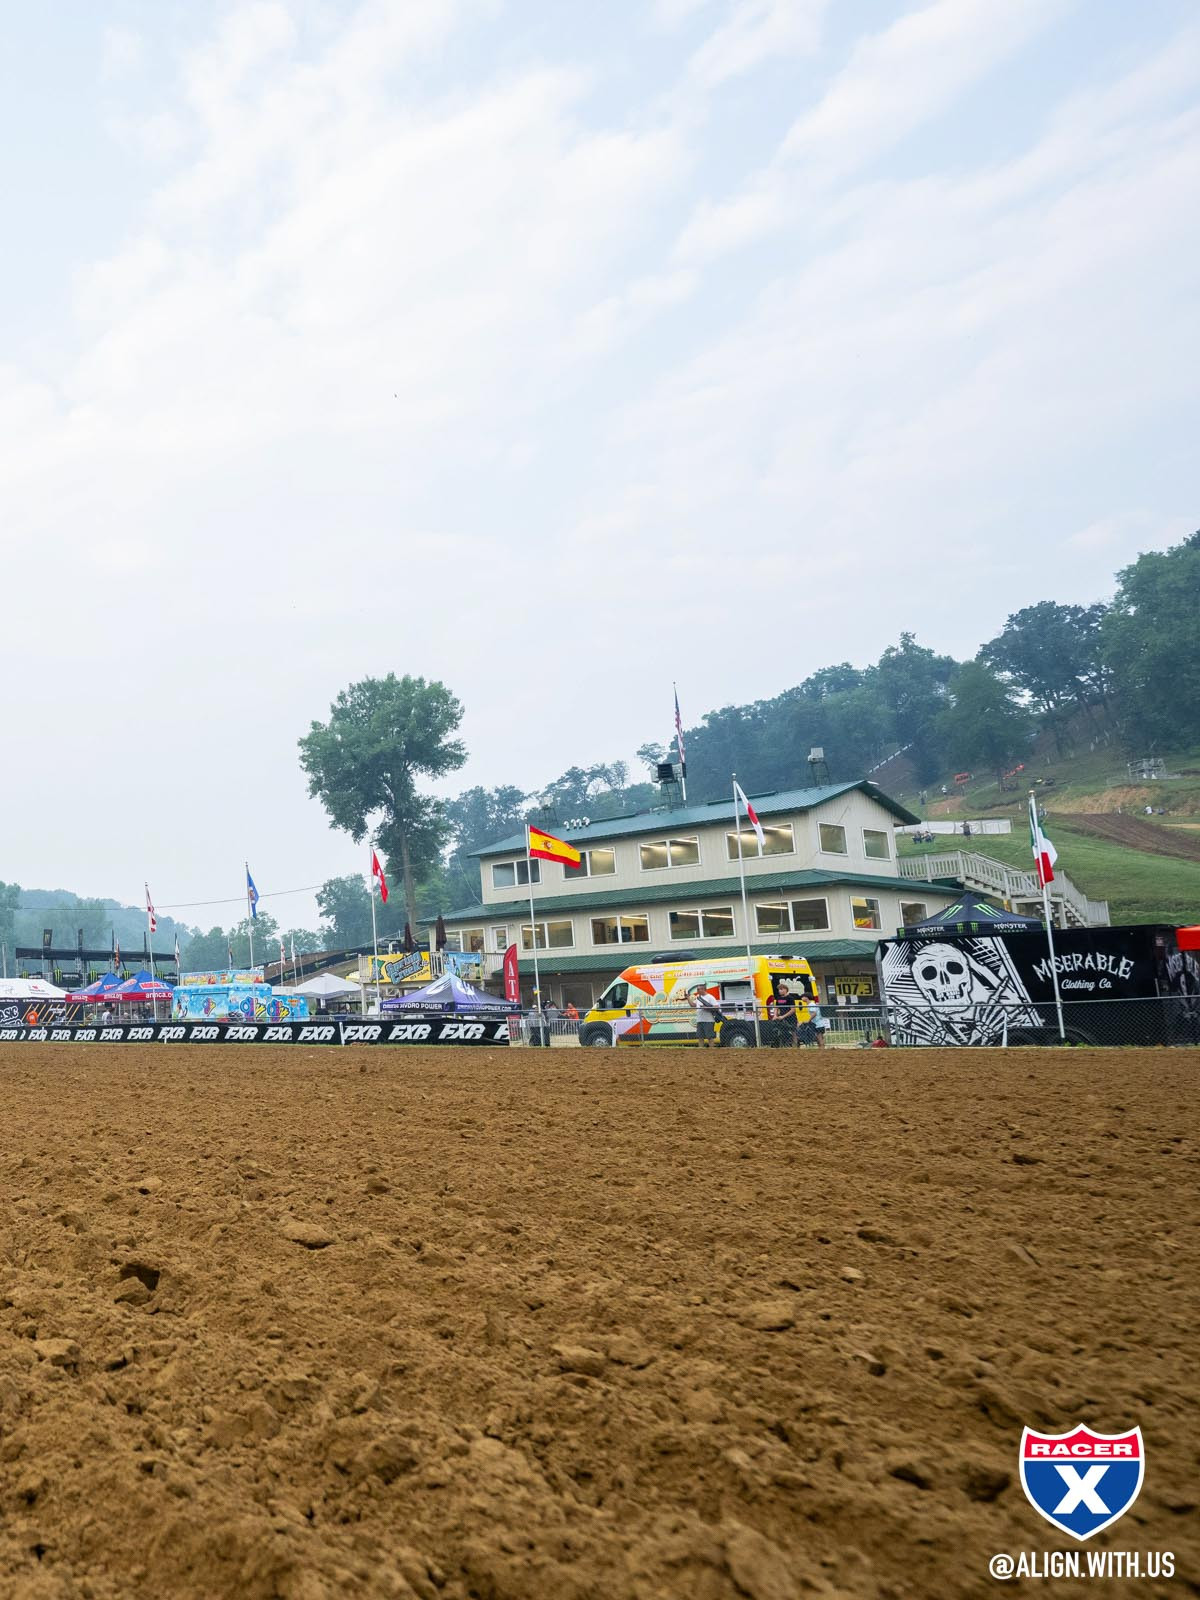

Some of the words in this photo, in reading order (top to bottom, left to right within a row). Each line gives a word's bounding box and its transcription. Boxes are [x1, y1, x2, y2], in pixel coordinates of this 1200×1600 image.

[838, 983, 873, 995] 107.3
[1061, 978, 1095, 991] Clothing
[0, 1030, 18, 1039] FXR
[50, 1029, 71, 1040] FXR
[74, 1029, 96, 1040] FXR
[100, 1029, 123, 1040] FXR
[127, 1028, 153, 1039] FXR
[158, 1027, 185, 1039] FXR
[190, 1027, 220, 1039] FXR
[225, 1027, 258, 1039] FXR
[298, 1026, 335, 1040] FXR
[343, 1025, 382, 1040] FXR
[388, 1024, 432, 1040] FXR
[438, 1024, 486, 1039] FXR
